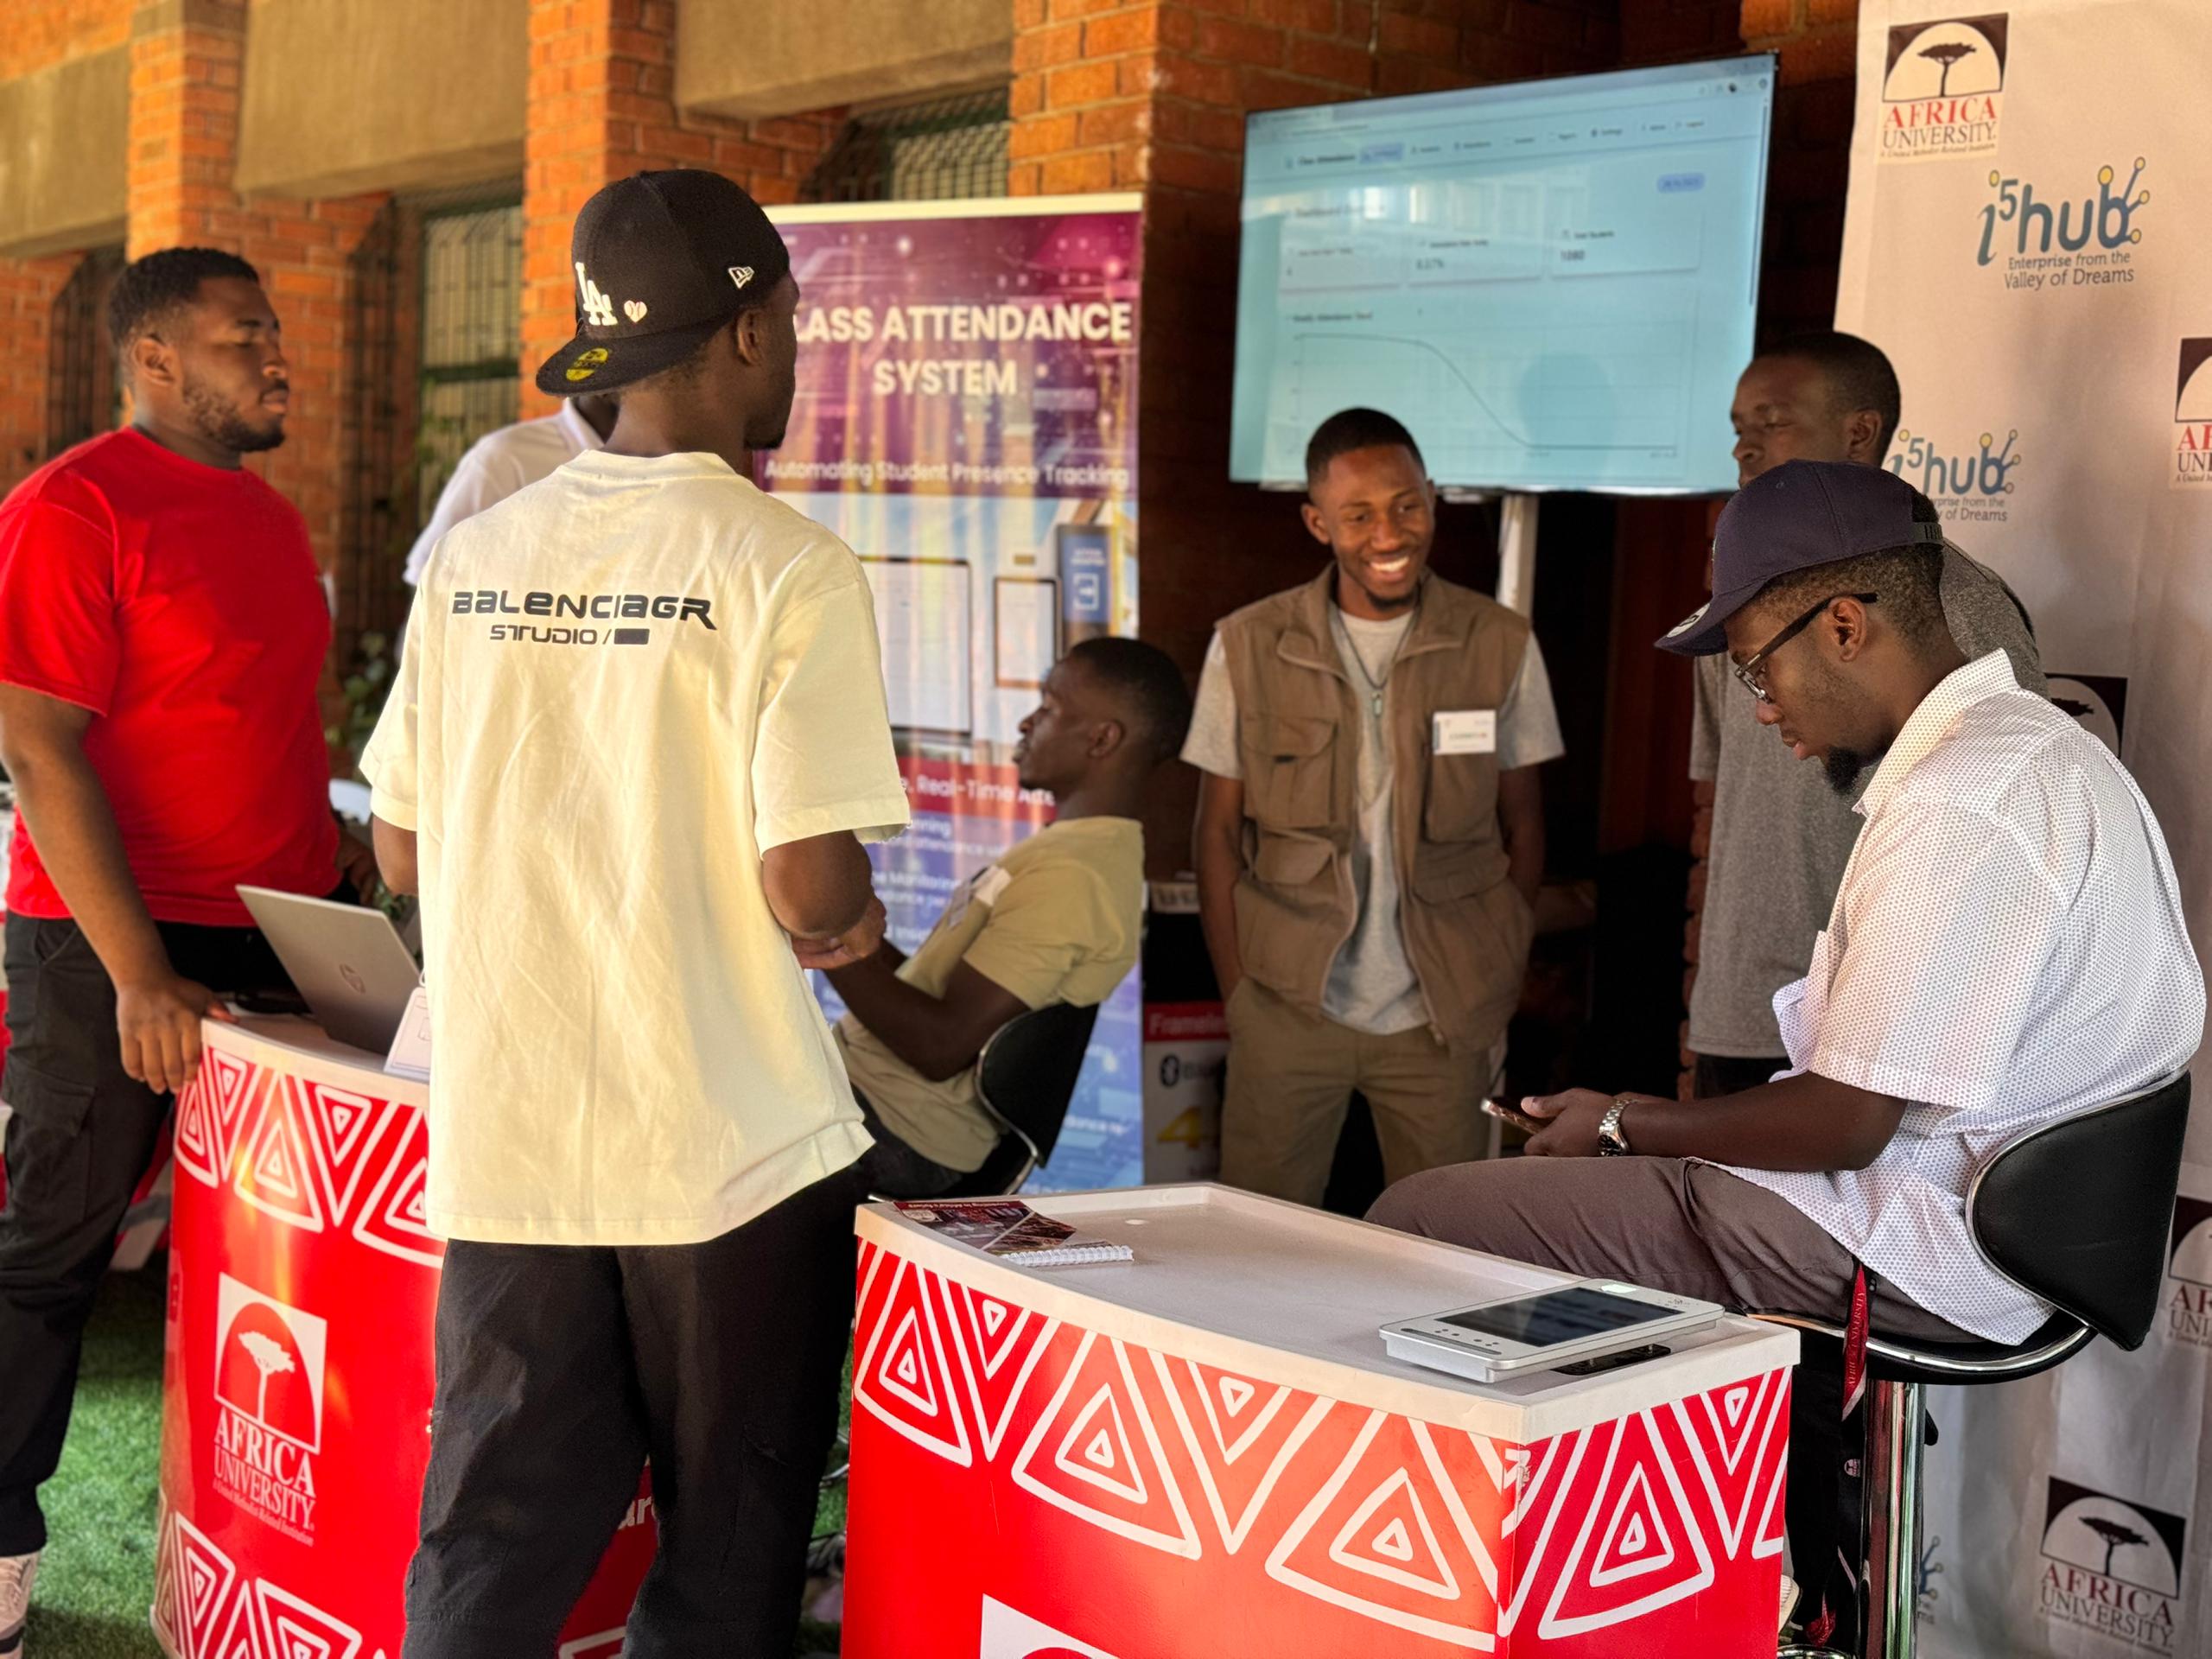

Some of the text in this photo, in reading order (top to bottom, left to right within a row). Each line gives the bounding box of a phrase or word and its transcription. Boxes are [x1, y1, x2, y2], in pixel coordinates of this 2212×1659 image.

[1884, 95, 1997, 128] AFRICA
[2008, 251, 2131, 270] Enterprise from the
[2005, 267, 2134, 291] Valley of Dreams
[792, 302, 1132, 343] LASS ATTENDANCE
[872, 359, 1018, 396] SYSTEM
[764, 459, 1129, 492] Automating Student Presence Tracking
[1961, 507, 2009, 522] Dreams
[490, 625, 598, 645] STUDIO
[213, 1406, 316, 1498] AFRICA
[2041, 1562, 2174, 1626] AFRICA
